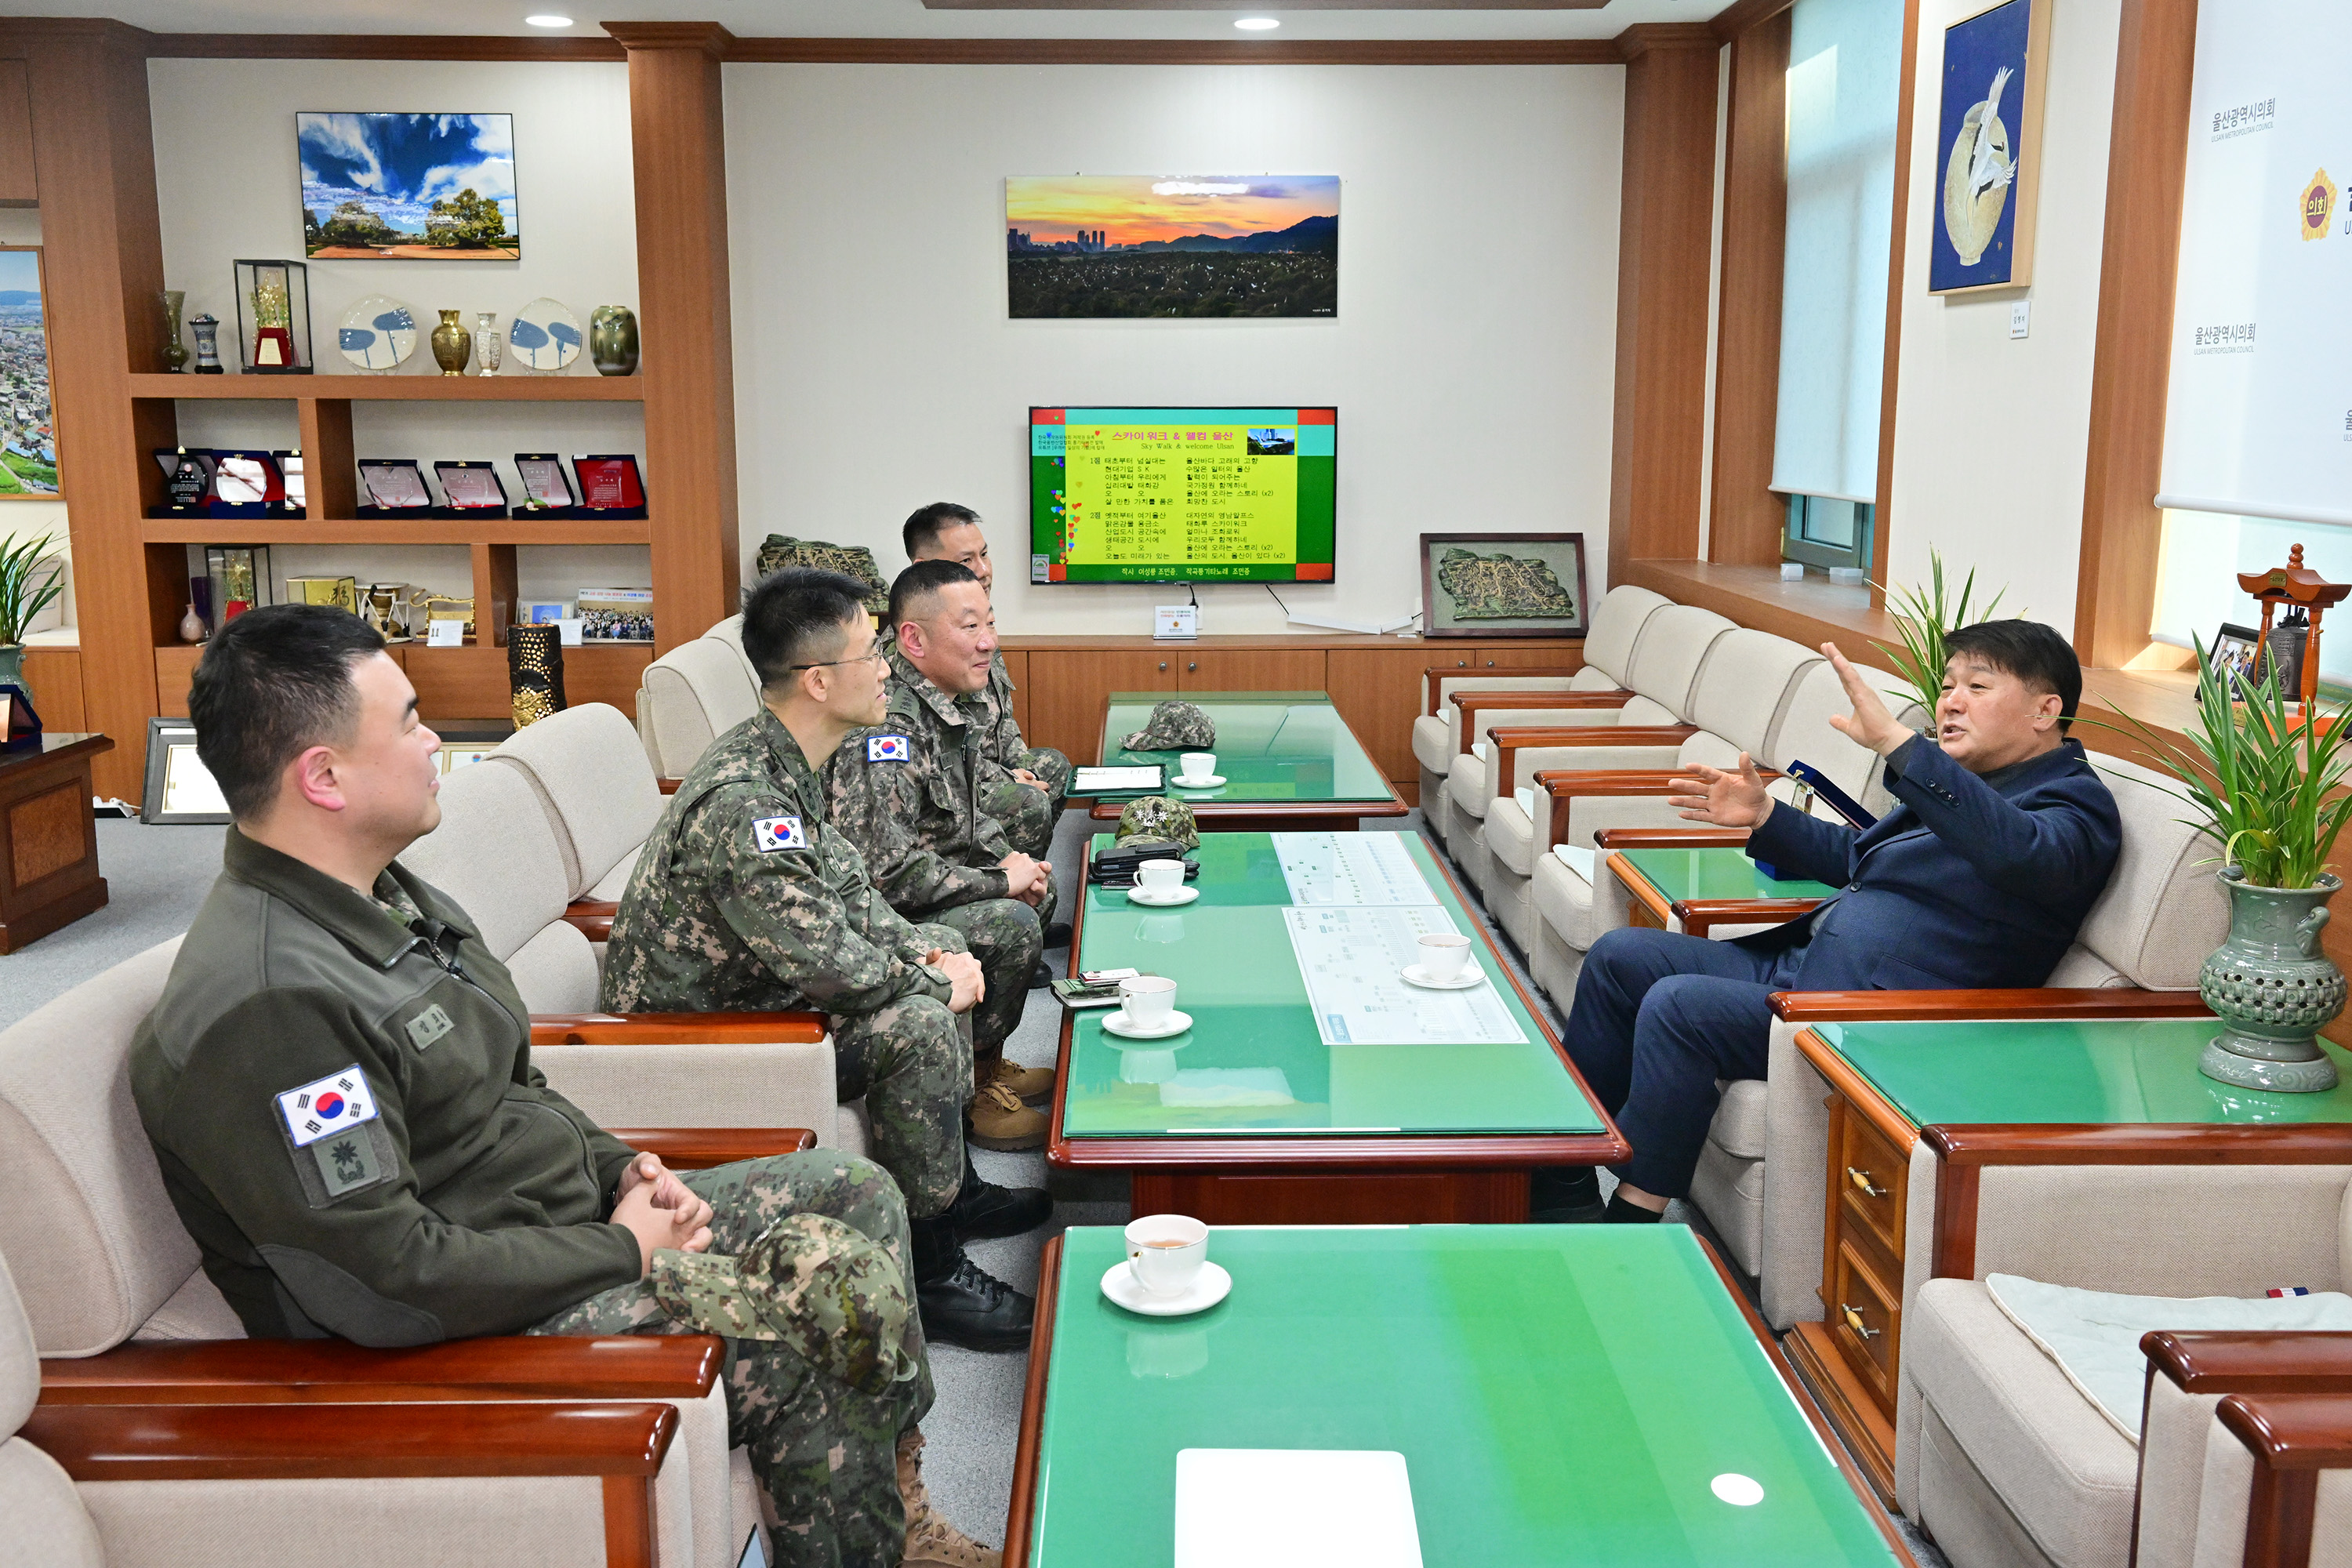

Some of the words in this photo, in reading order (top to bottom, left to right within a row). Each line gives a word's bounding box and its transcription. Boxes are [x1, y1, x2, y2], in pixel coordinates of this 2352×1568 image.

[2212, 97, 2276, 132] 울산광역시의회
[2211, 133, 2224, 143] ULSAN
[2225, 125, 2256, 140] METROPOLITAN
[2256, 121, 2274, 132] COUNCIL
[2307, 194, 2327, 216] 의회
[2195, 323, 2256, 346] 울산광역시의회
[2237, 345, 2254, 354] COUNCIL
[1112, 432, 1144, 441] 스카이
[1212, 432, 1233, 441] 울산
